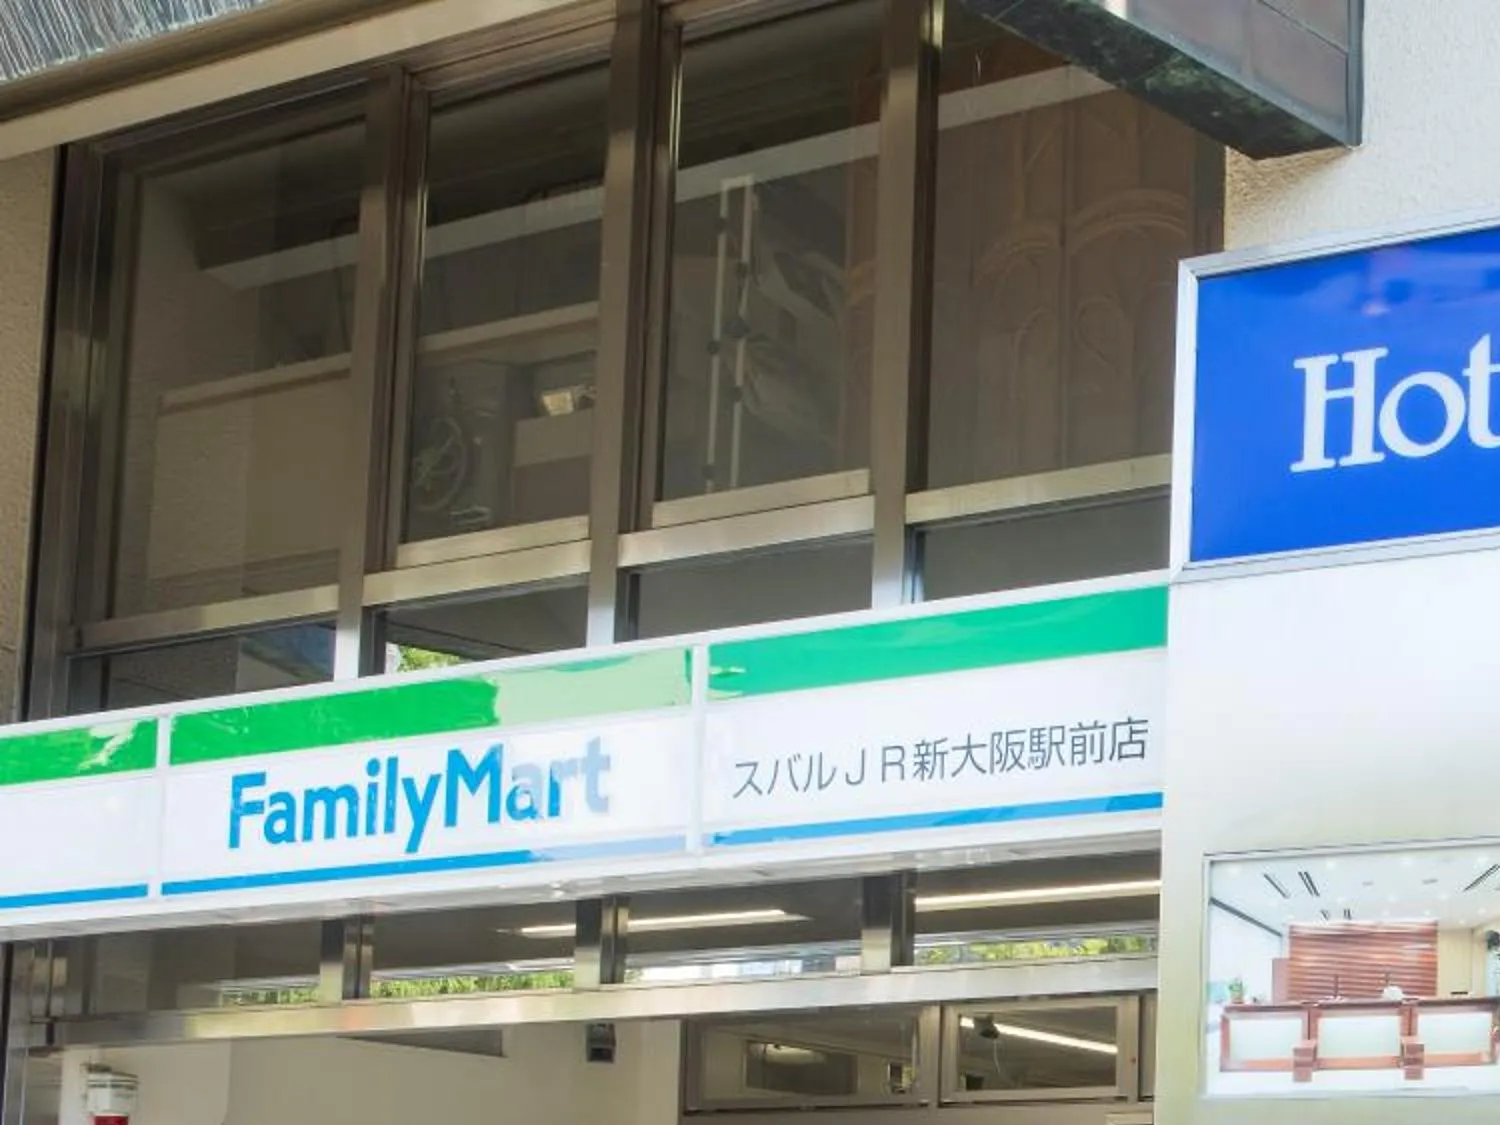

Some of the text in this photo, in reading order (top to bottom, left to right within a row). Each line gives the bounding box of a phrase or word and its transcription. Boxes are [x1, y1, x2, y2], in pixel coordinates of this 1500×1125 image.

[228, 736, 612, 854] FamilyMart
[733, 715, 1149, 799] スバルJR新大阪駅前店
